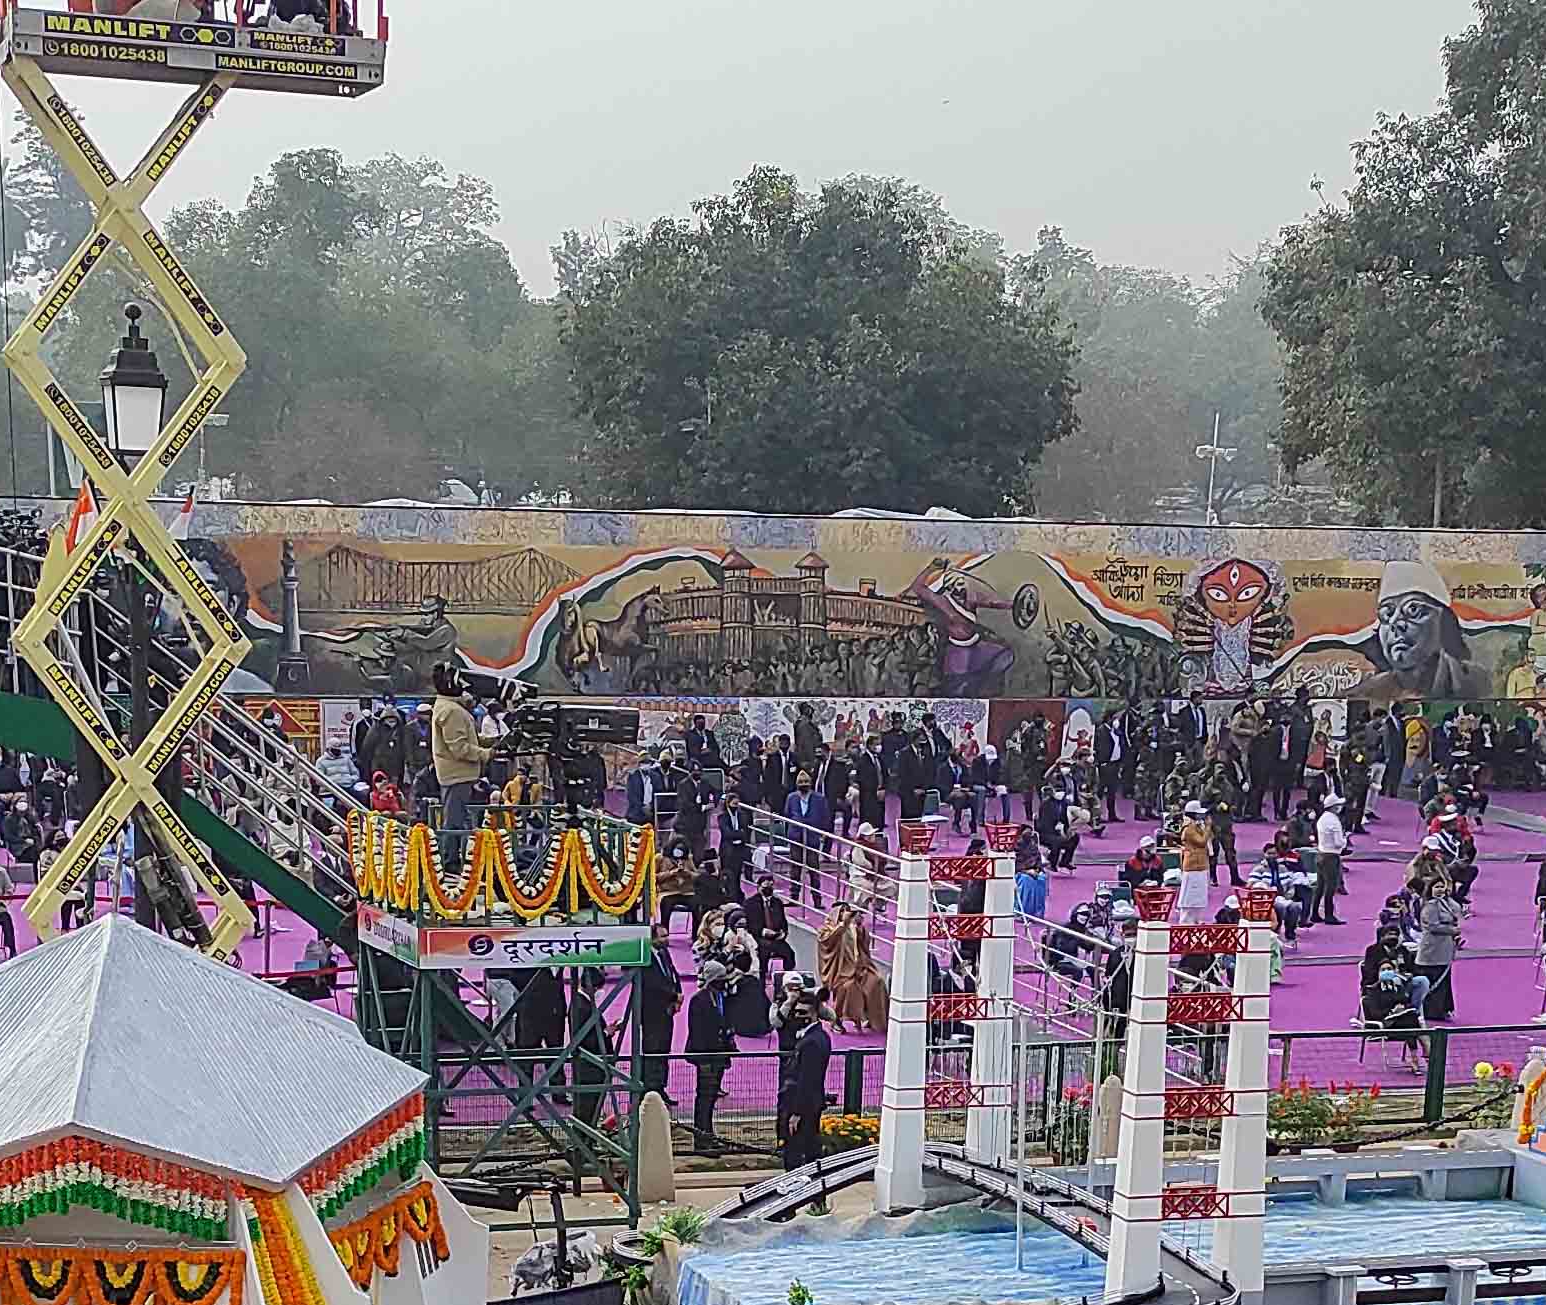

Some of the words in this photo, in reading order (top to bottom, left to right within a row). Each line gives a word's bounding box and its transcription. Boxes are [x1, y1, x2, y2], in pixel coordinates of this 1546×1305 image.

[47, 15, 171, 40] MANLIFT
[60, 43, 166, 62] 18001025438
[253, 31, 313, 45] MANLIFT
[217, 55, 355, 78] MANLIFTGROUP.COM
[148, 116, 198, 180] MANLIFT
[146, 232, 196, 300] MANLIFT
[36, 266, 87, 330] MANLIFT
[50, 553, 99, 615] MANLIFT
[49, 667, 100, 728] MANLIFT
[148, 661, 232, 772] MANLIFTGROUP.COM
[155, 803, 206, 865] MANLIFT
[501, 932, 605, 963] दूरदर्शन
